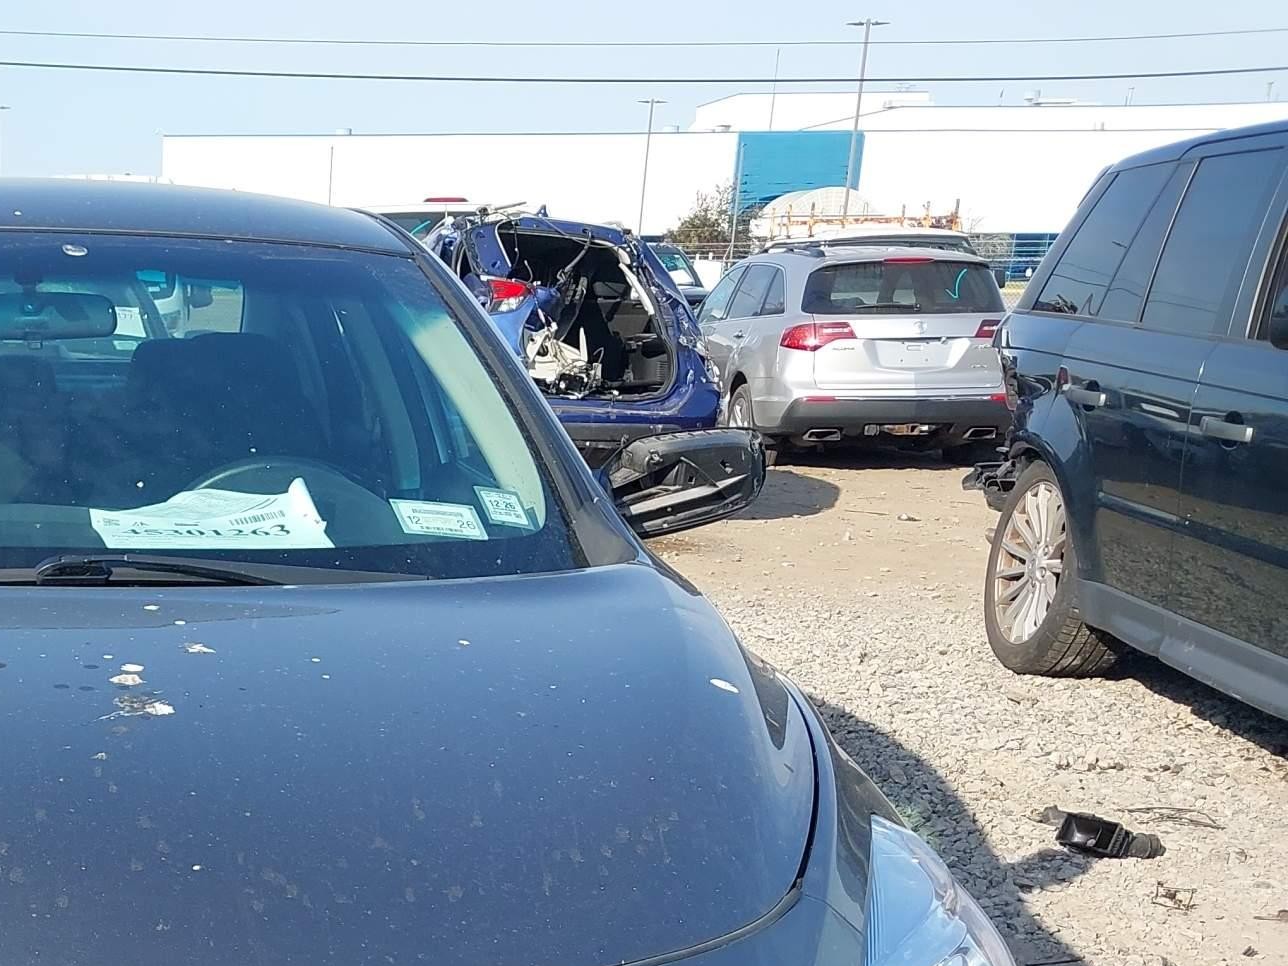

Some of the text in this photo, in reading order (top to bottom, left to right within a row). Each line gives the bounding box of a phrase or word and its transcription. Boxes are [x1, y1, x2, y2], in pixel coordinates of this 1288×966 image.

[406, 515, 423, 525] 12
[456, 519, 476, 530] 26
[121, 524, 291, 537] 45301263
